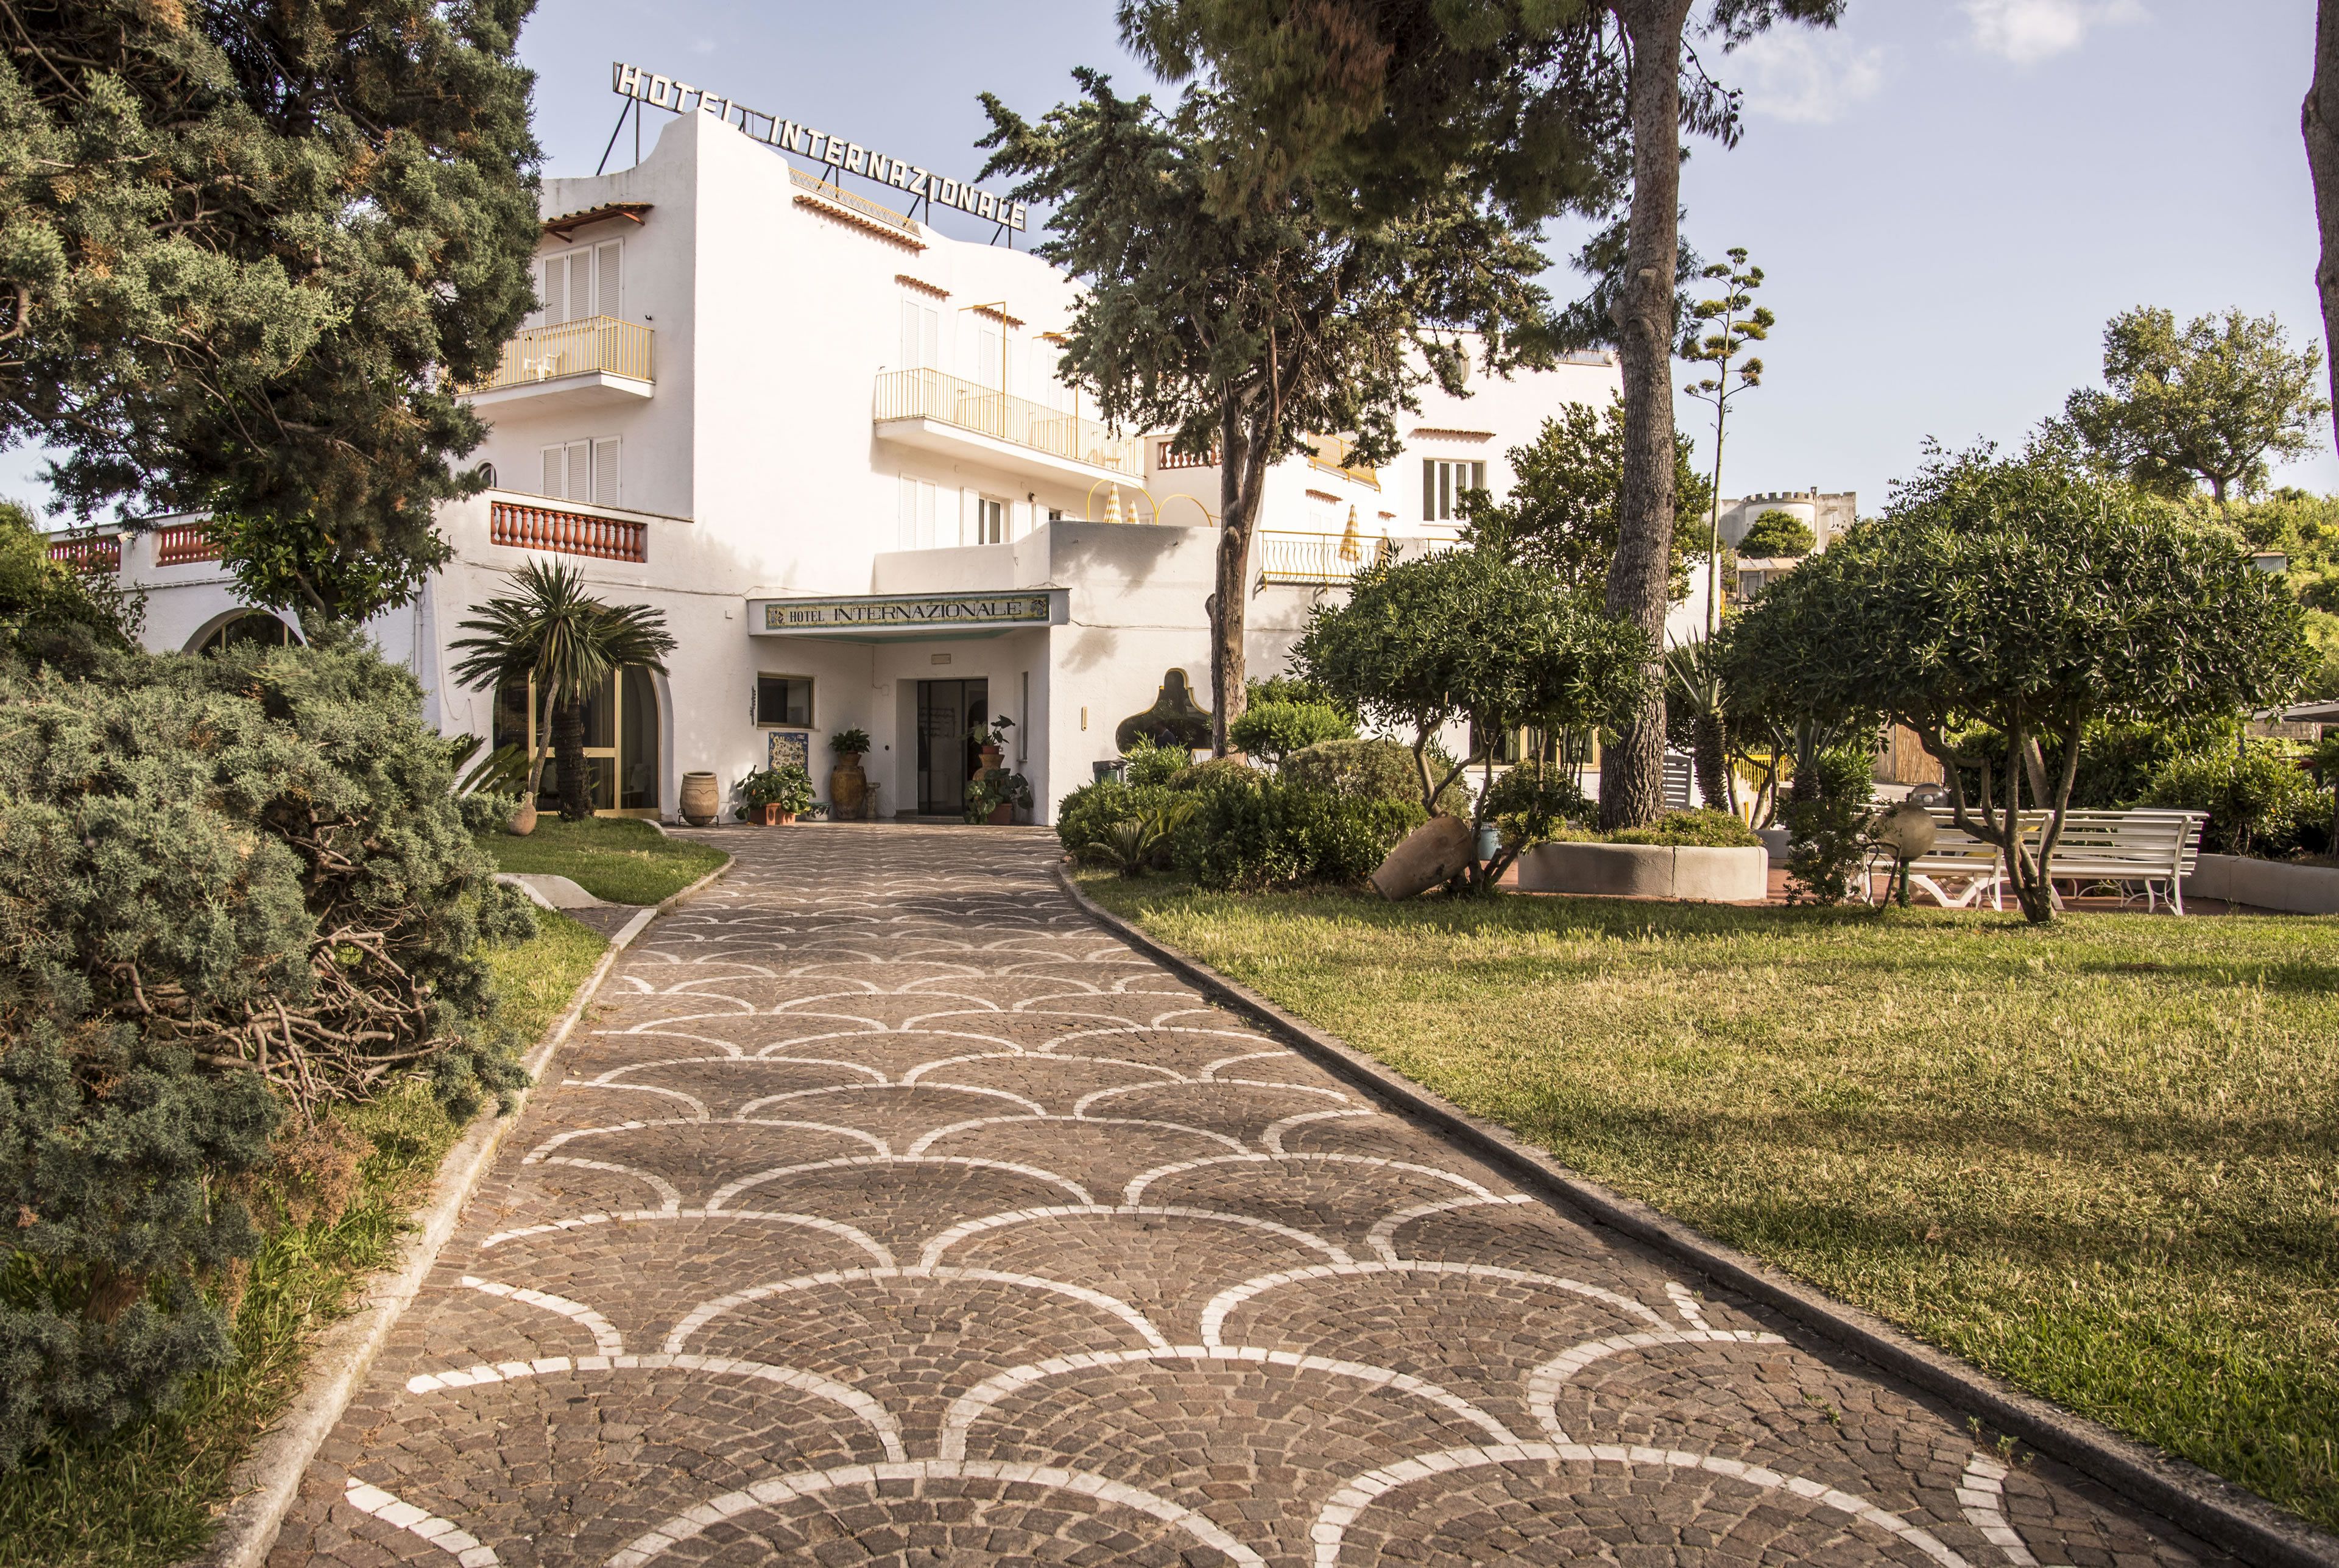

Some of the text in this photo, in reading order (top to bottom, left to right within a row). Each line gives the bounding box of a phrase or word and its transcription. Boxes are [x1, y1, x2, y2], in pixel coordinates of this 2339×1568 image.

[617, 63, 1026, 230] HOTEL INTERNAZIONALE
[790, 601, 1021, 623] HOTEL INTERNAZIONALE
